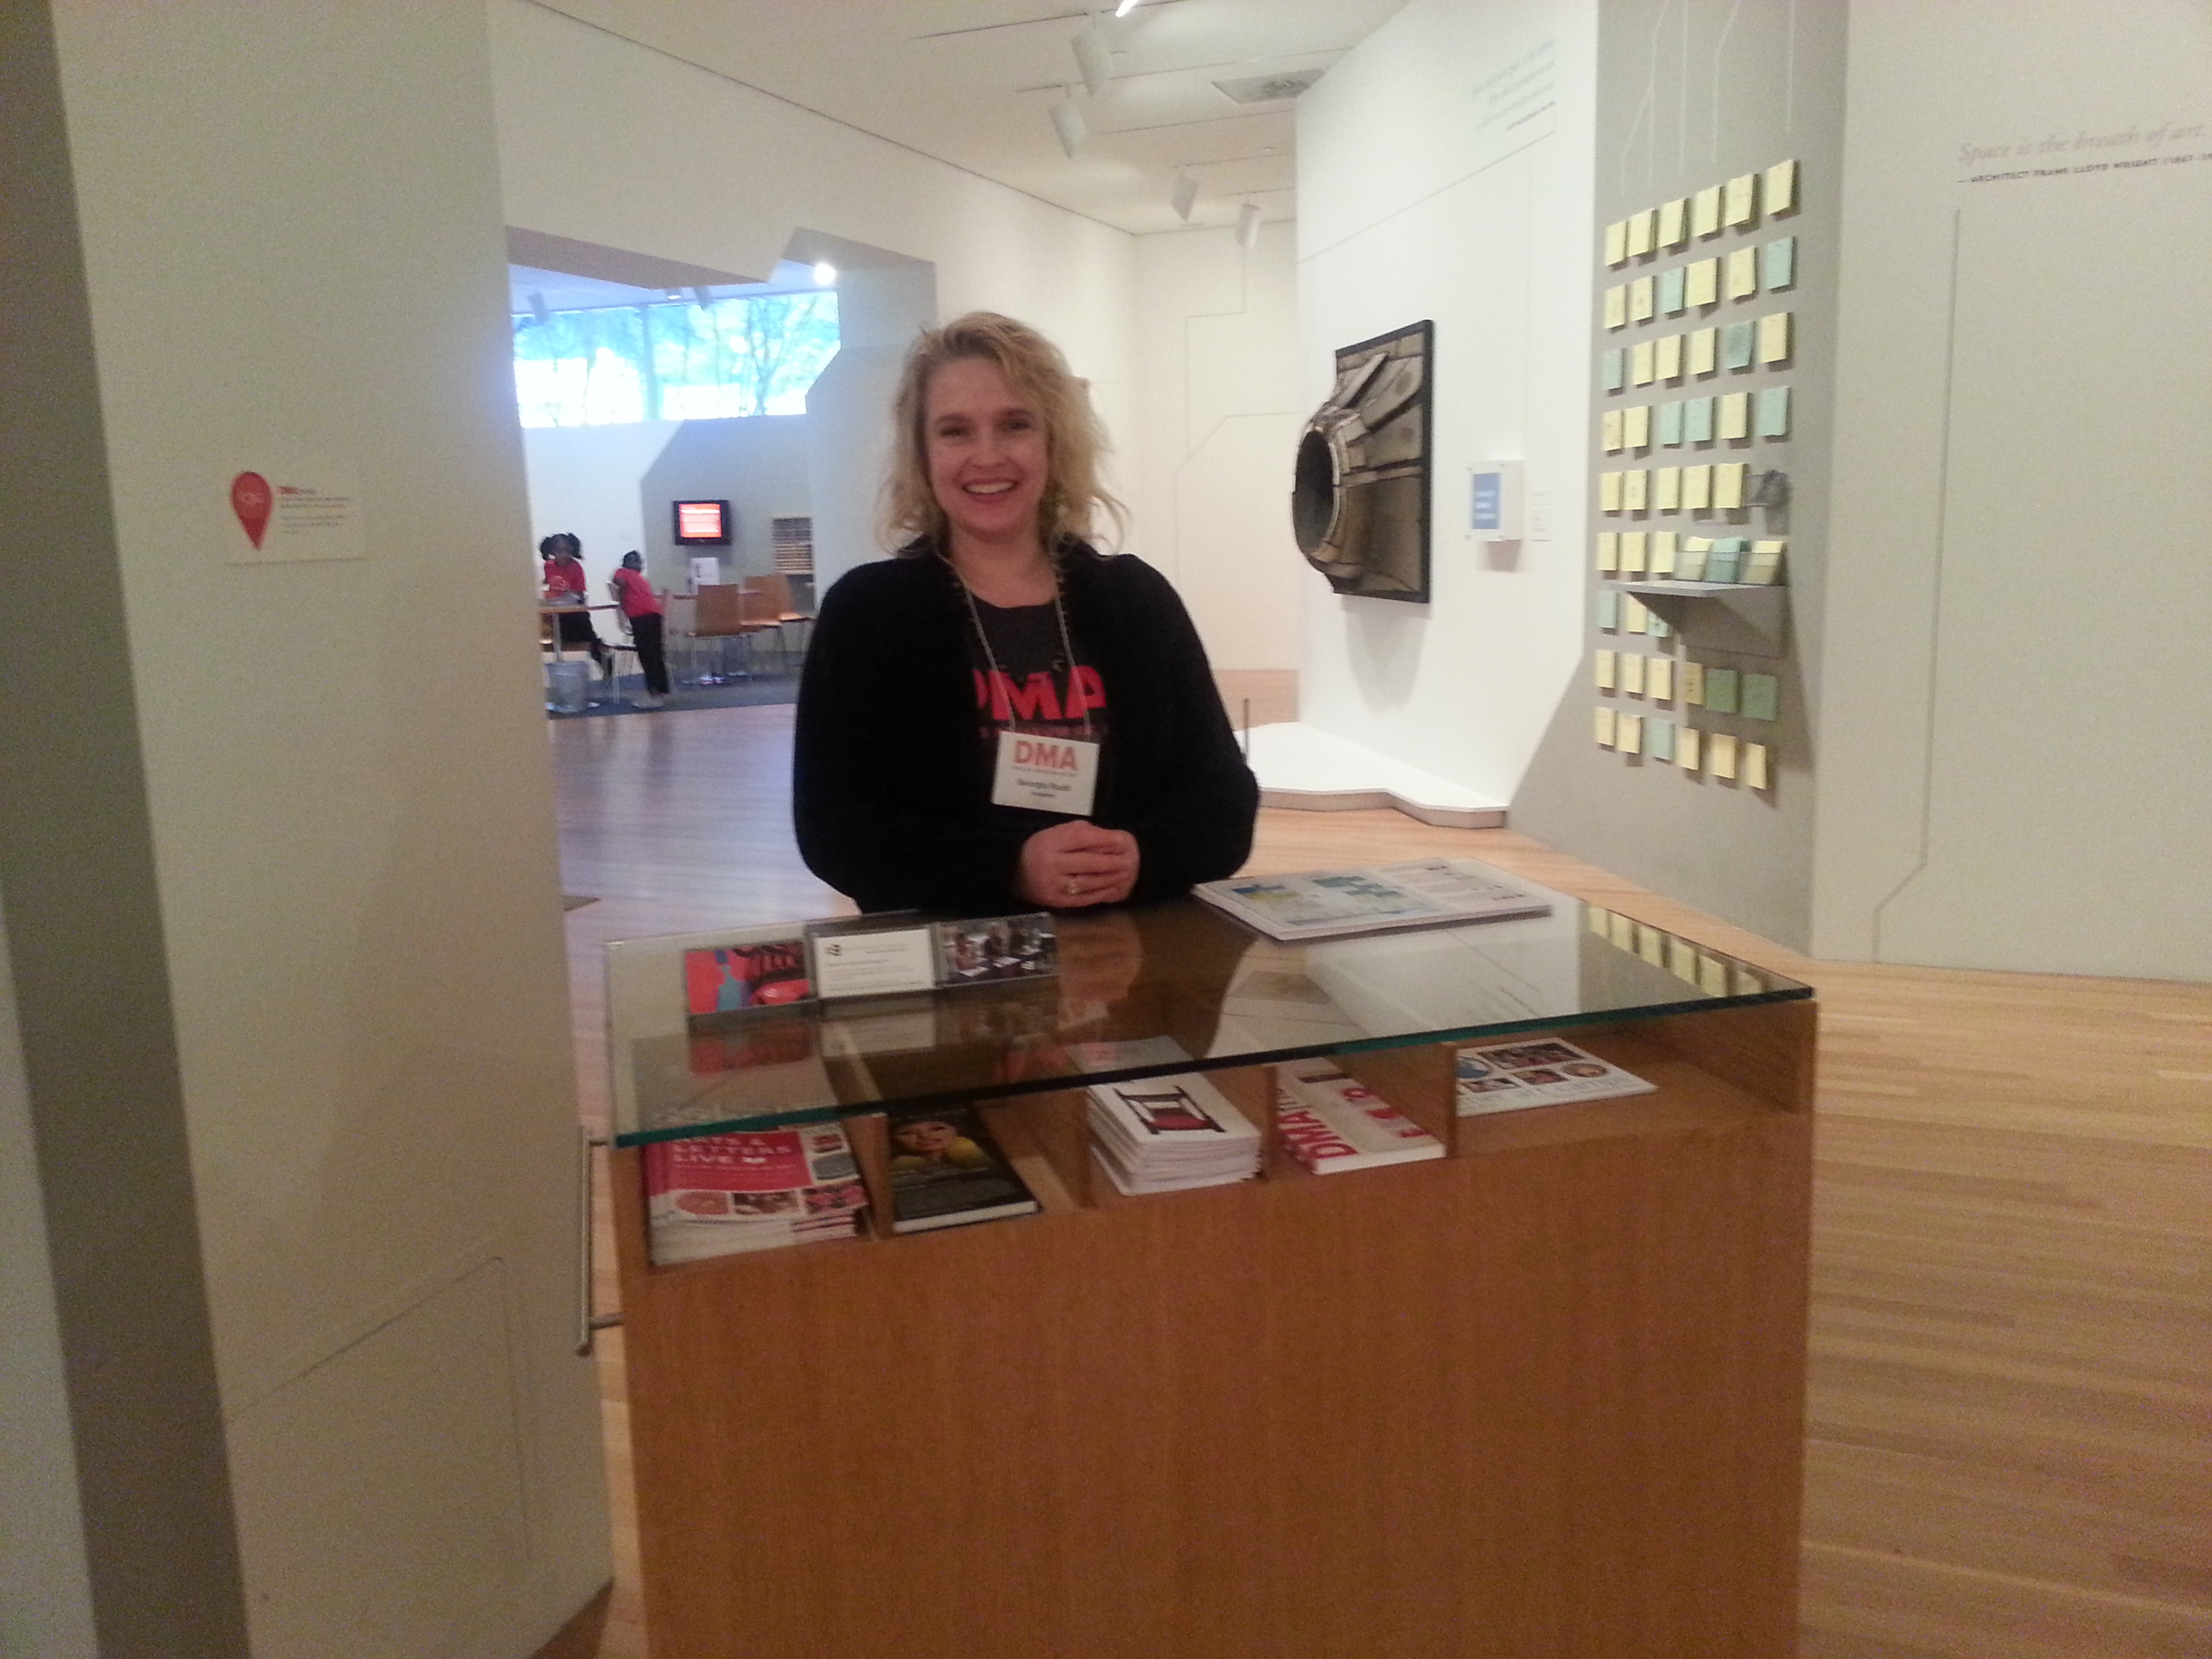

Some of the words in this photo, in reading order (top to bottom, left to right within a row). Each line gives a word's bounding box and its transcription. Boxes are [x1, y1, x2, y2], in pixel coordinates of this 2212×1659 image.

[1956, 142, 2011, 166] Space
[2014, 141, 2032, 157] is
[2037, 134, 2070, 153] the
[2074, 125, 2139, 150] breath
[2144, 121, 2174, 149] of
[1971, 170, 2030, 183] ARCHITECT
[2034, 167, 2069, 177] FRANK
[2074, 163, 2110, 173] LLOYD
[2112, 157, 2160, 168] WRIGHT
[1015, 739, 1078, 771] DMA
[673, 1144, 792, 1154] LETTERS
[1276, 1110, 1357, 1160] DMA
[674, 1154, 734, 1163] LIVE
